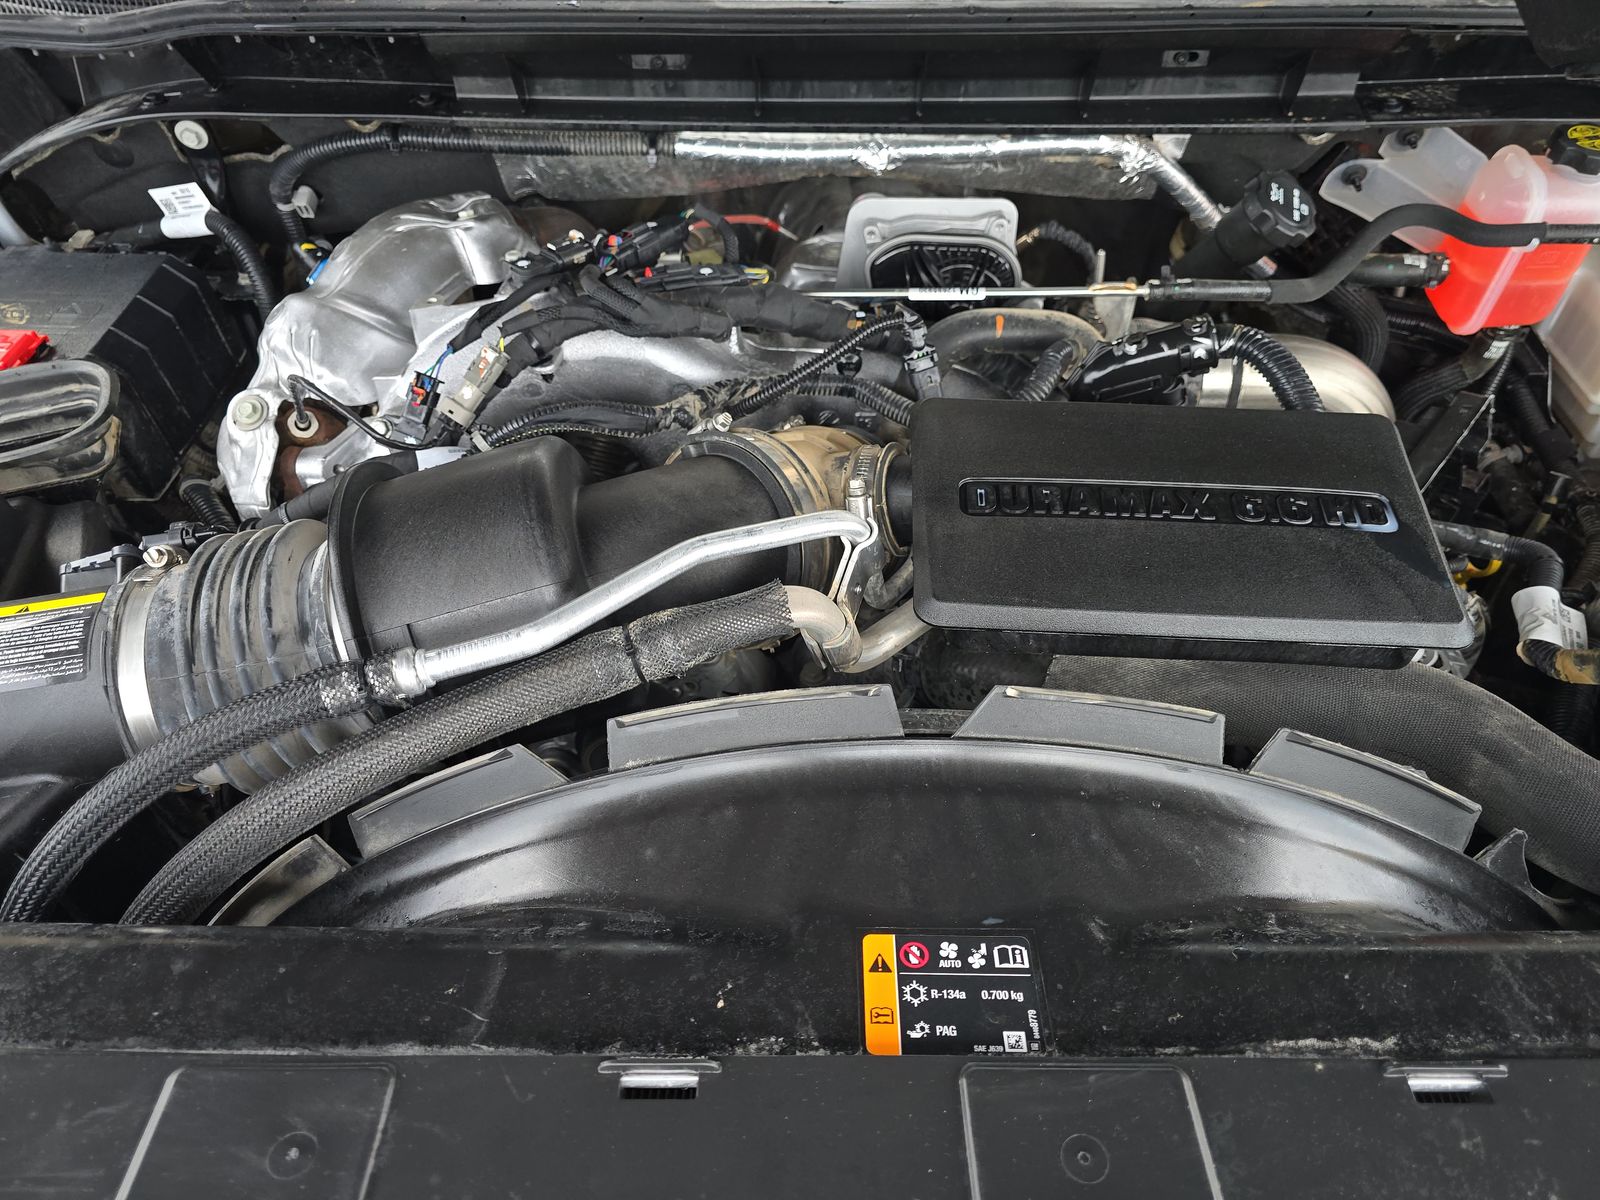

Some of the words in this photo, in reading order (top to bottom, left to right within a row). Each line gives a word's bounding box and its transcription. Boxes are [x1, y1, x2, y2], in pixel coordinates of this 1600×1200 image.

[968, 485, 1216, 520] DURAMAX
[1231, 492, 1313, 525] 6.6
[1320, 497, 1394, 529] HD
[939, 960, 962, 968] AUTO
[930, 989, 966, 999] R-134a
[981, 990, 1009, 1000] 0.700
[1010, 990, 1024, 1002] kg
[936, 1025, 957, 1037] PAG
